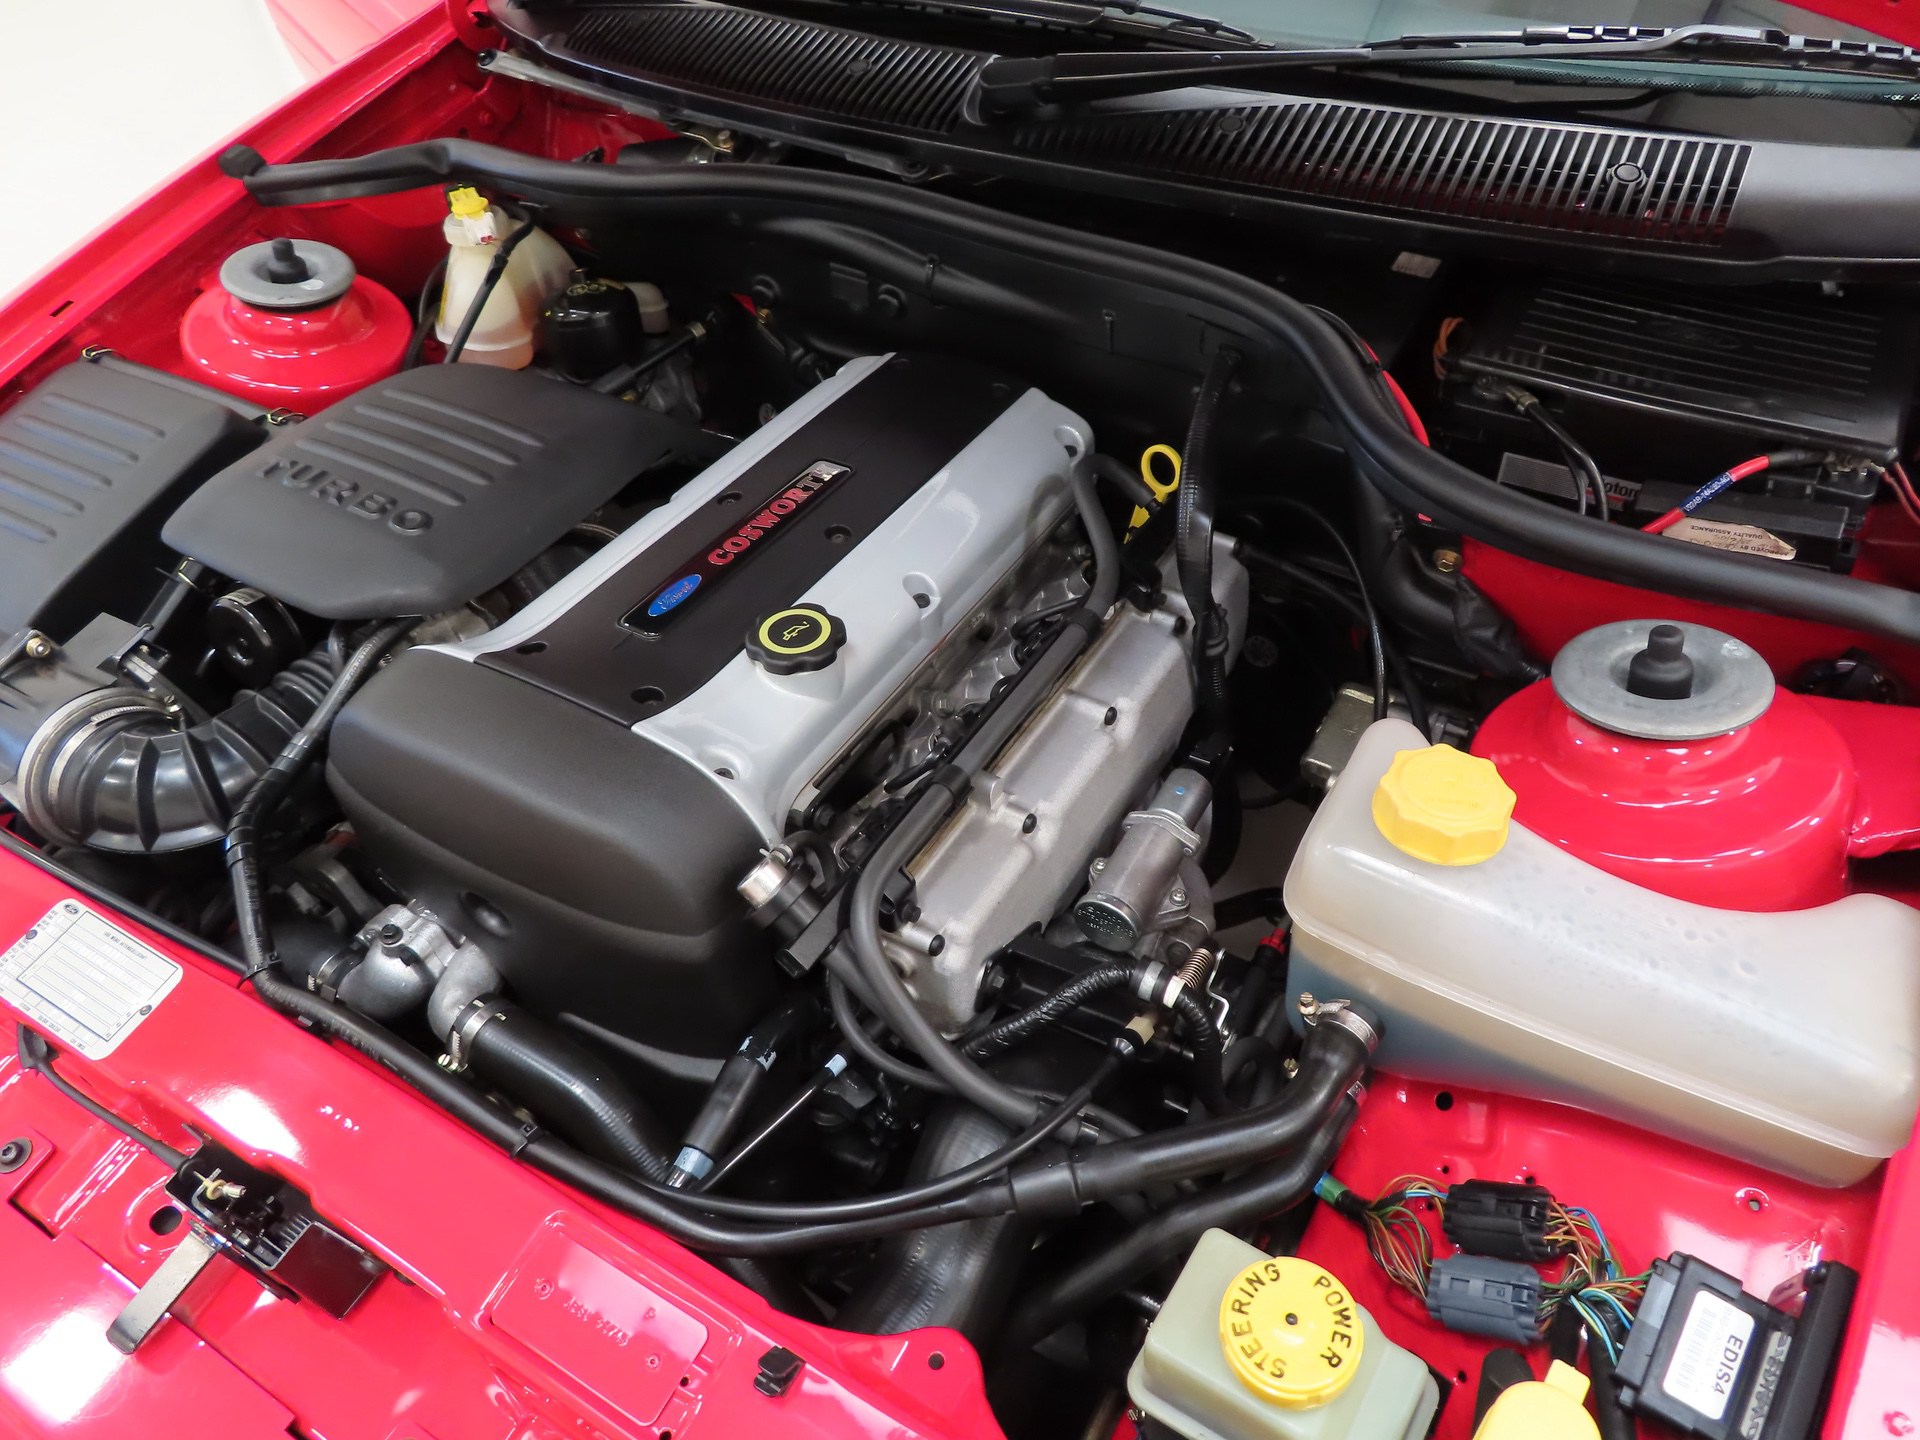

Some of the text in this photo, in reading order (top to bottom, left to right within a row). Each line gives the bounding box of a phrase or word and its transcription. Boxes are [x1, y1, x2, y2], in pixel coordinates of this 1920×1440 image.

[256, 456, 434, 536] TURBO
[707, 462, 841, 566] COSWORTH
[1690, 524, 1763, 540] QUALITY ASSURANCE
[1231, 1262, 1287, 1379] STEERING
[1313, 1275, 1352, 1369] POWER
[1713, 1334, 1744, 1395] EDIS4
